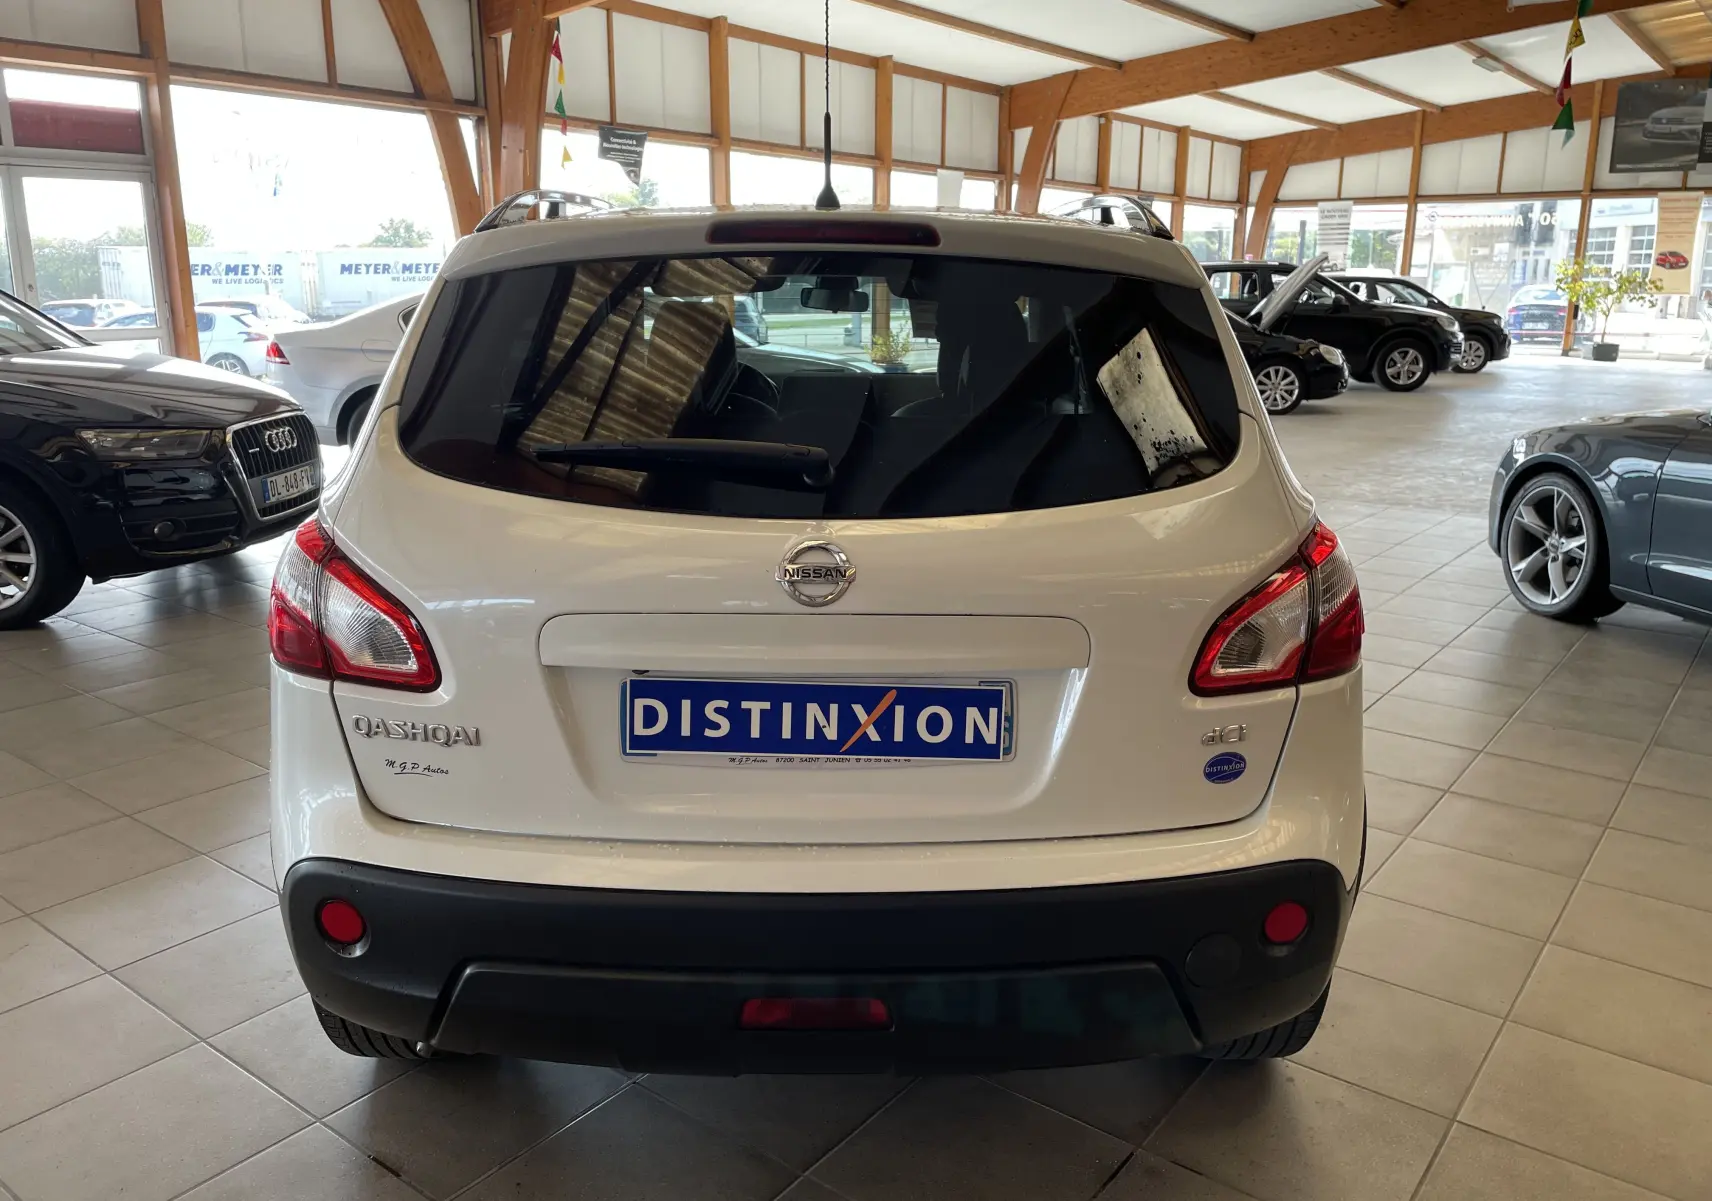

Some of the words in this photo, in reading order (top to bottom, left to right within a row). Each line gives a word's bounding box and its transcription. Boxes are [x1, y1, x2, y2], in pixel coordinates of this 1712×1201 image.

[784, 568, 847, 579] NISSAN
[633, 690, 999, 751] DISTINXION
[352, 714, 481, 747] QASHQAI
[422, 764, 449, 775] Autos
[1206, 761, 1245, 773] DISTINXION
